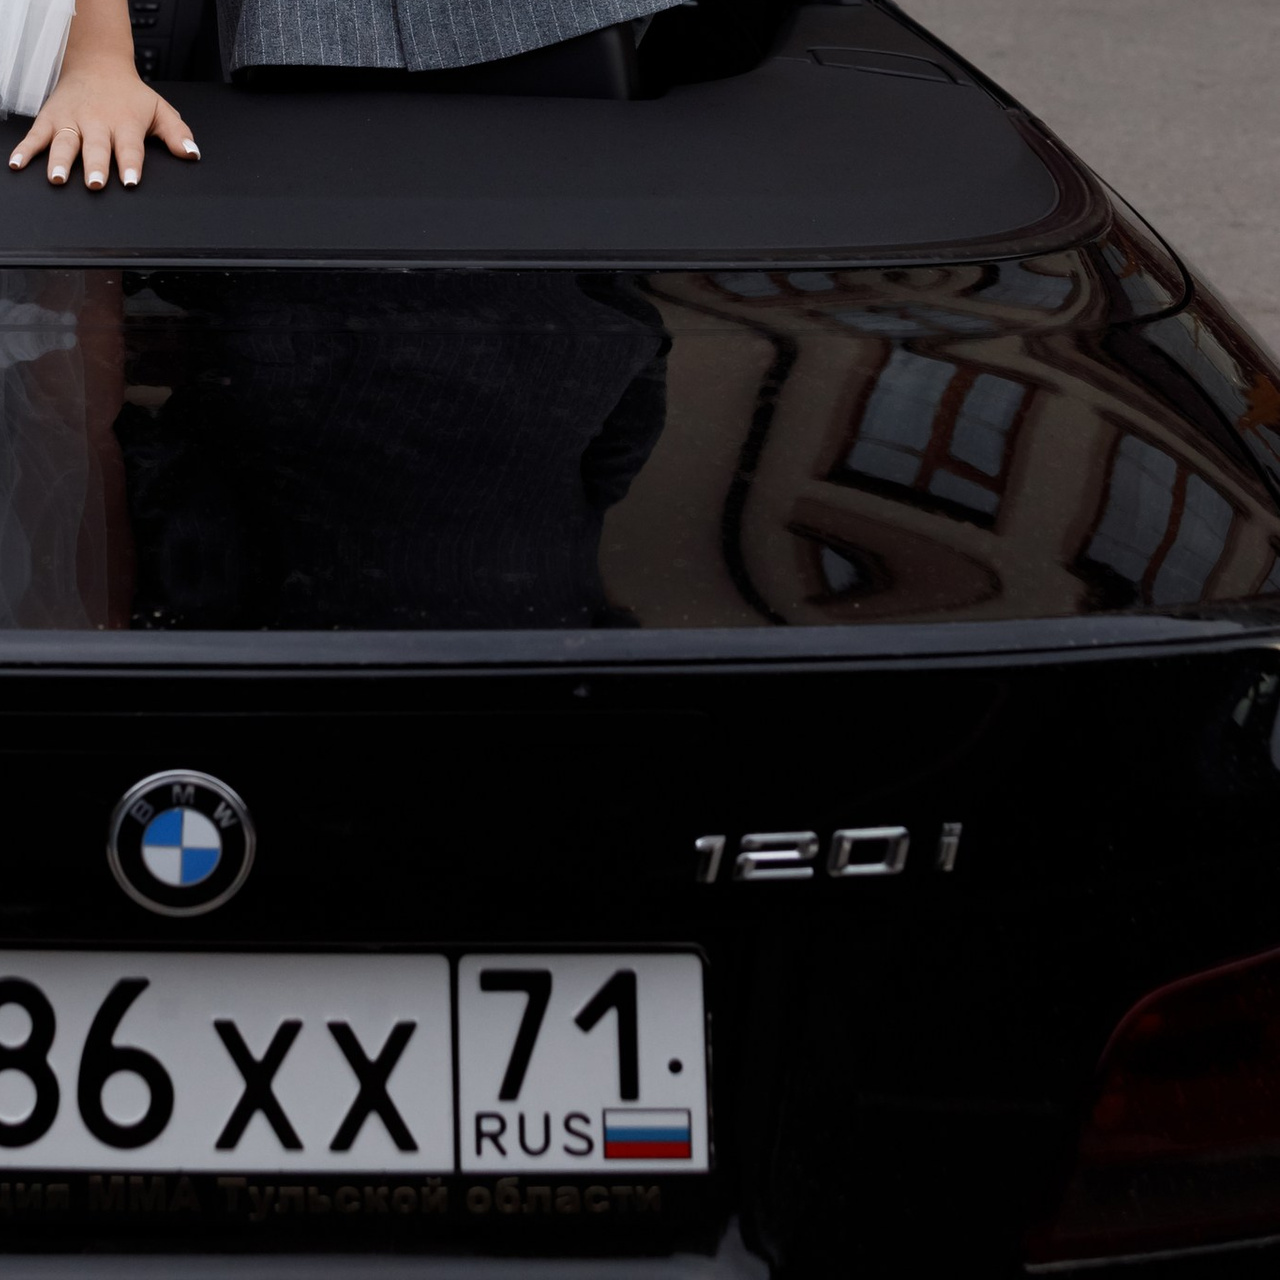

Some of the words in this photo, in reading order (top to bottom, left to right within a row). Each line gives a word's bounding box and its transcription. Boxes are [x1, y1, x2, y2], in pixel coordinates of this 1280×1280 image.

[129, 784, 238, 829] BMW
[479, 970, 640, 1101] 71
[475, 1113, 595, 1157] RUS
[217, 1176, 449, 1222] Тульской
[465, 1176, 664, 1216] области
